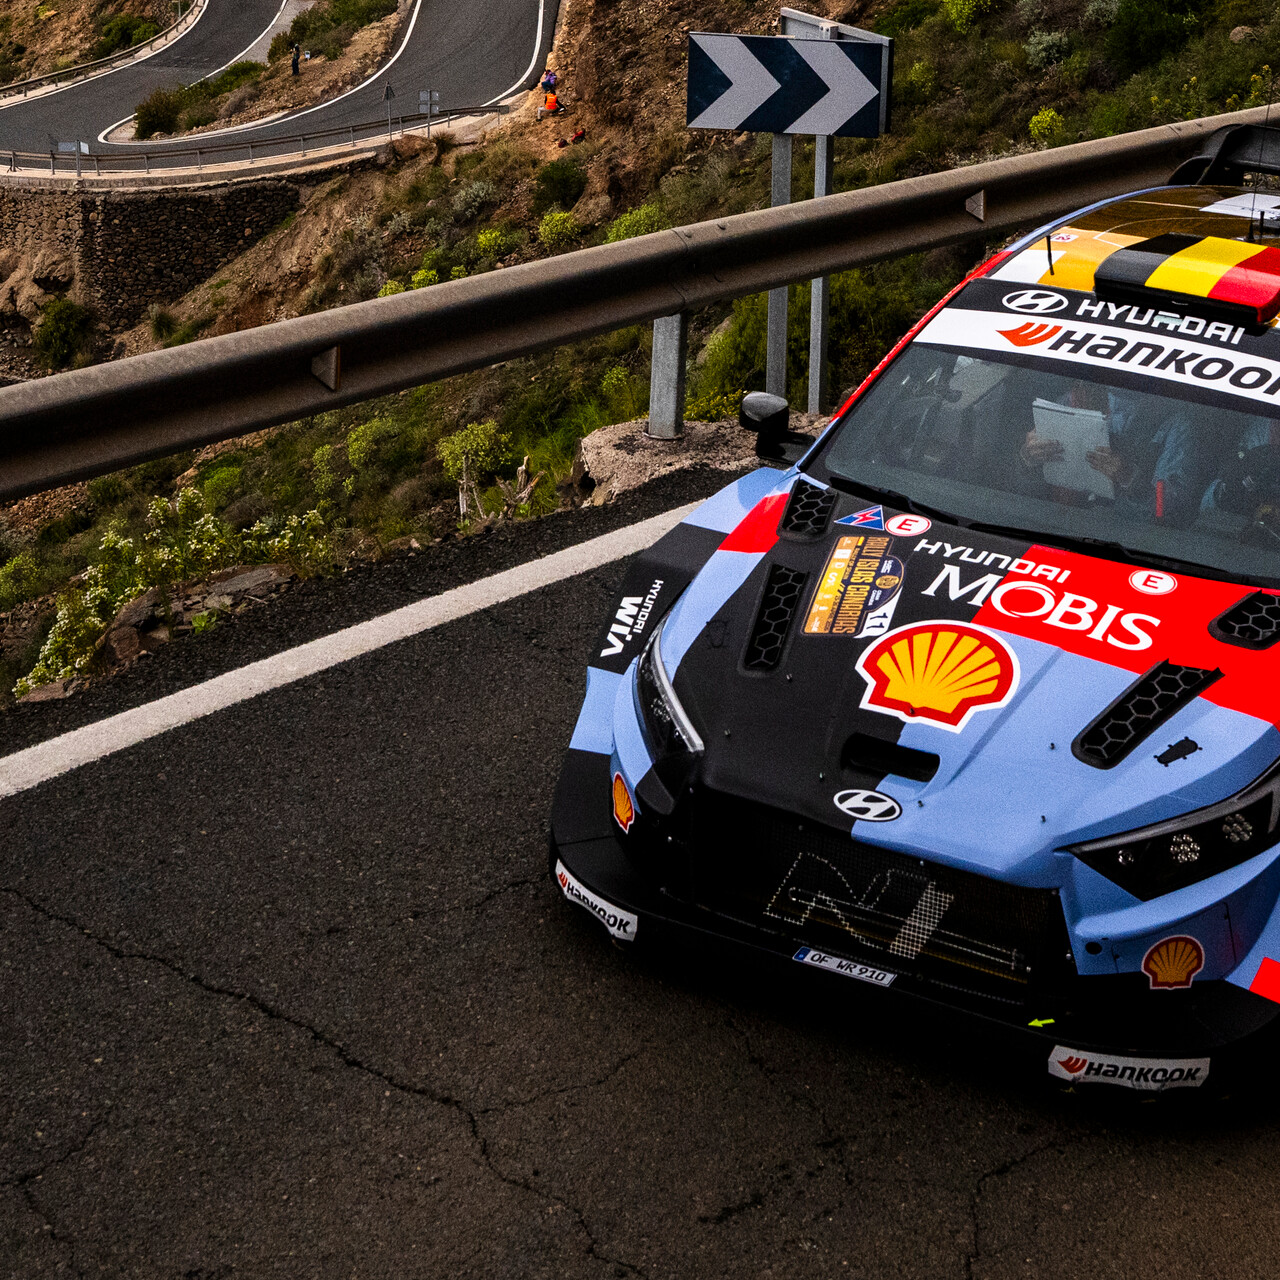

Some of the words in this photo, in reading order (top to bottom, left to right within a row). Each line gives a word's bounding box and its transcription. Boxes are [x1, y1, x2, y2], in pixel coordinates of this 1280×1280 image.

[1076, 298, 1245, 345] HYUNDAI
[896, 518, 919, 532] E
[862, 536, 889, 557] RALLY
[914, 538, 1071, 584] HYUNDAI
[850, 559, 880, 583] ISLAS
[1141, 574, 1163, 588] E
[633, 579, 664, 633] HYUNDAI
[832, 585, 870, 633] CANARIAS
[921, 563, 1161, 651] MOBIS
[866, 613, 888, 629] 11
[811, 953, 832, 964] OF
[836, 960, 857, 973] WR
[858, 966, 887, 982] 910
